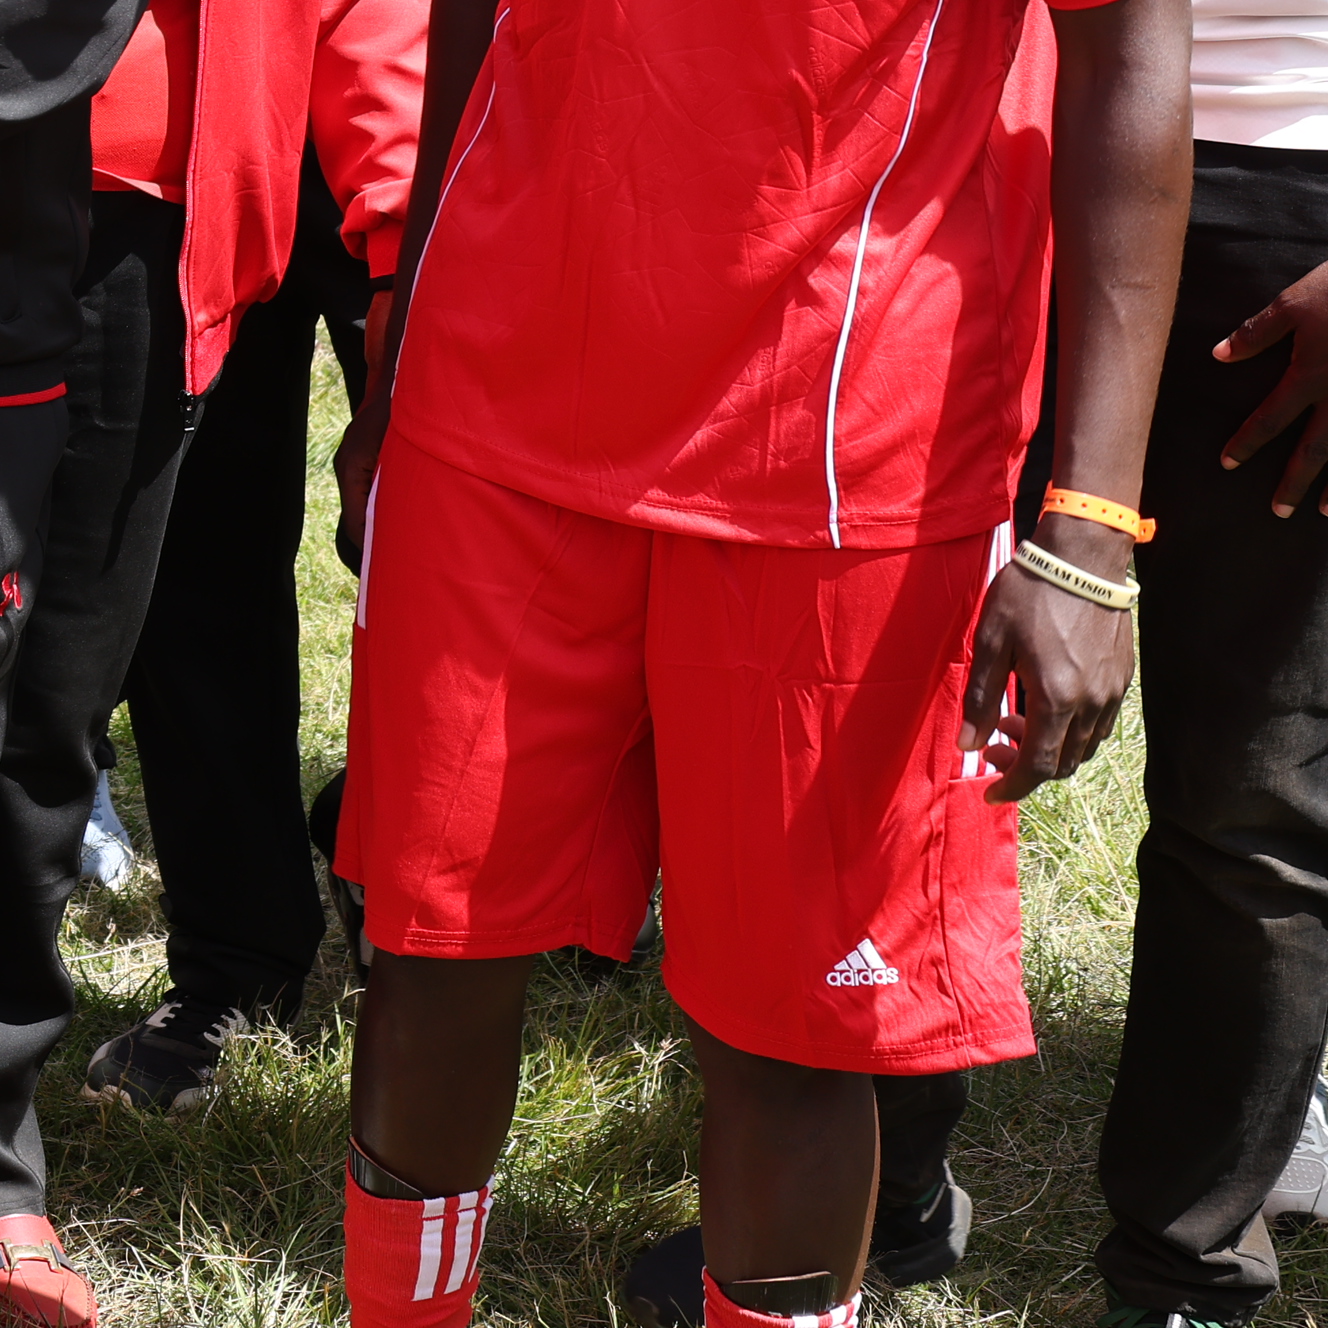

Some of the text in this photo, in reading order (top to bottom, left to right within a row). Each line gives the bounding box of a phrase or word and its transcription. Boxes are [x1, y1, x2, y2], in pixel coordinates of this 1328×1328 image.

[1028, 552, 1072, 582] DREAM
[1073, 576, 1115, 600] VISION
[826, 967, 900, 987] adidas
